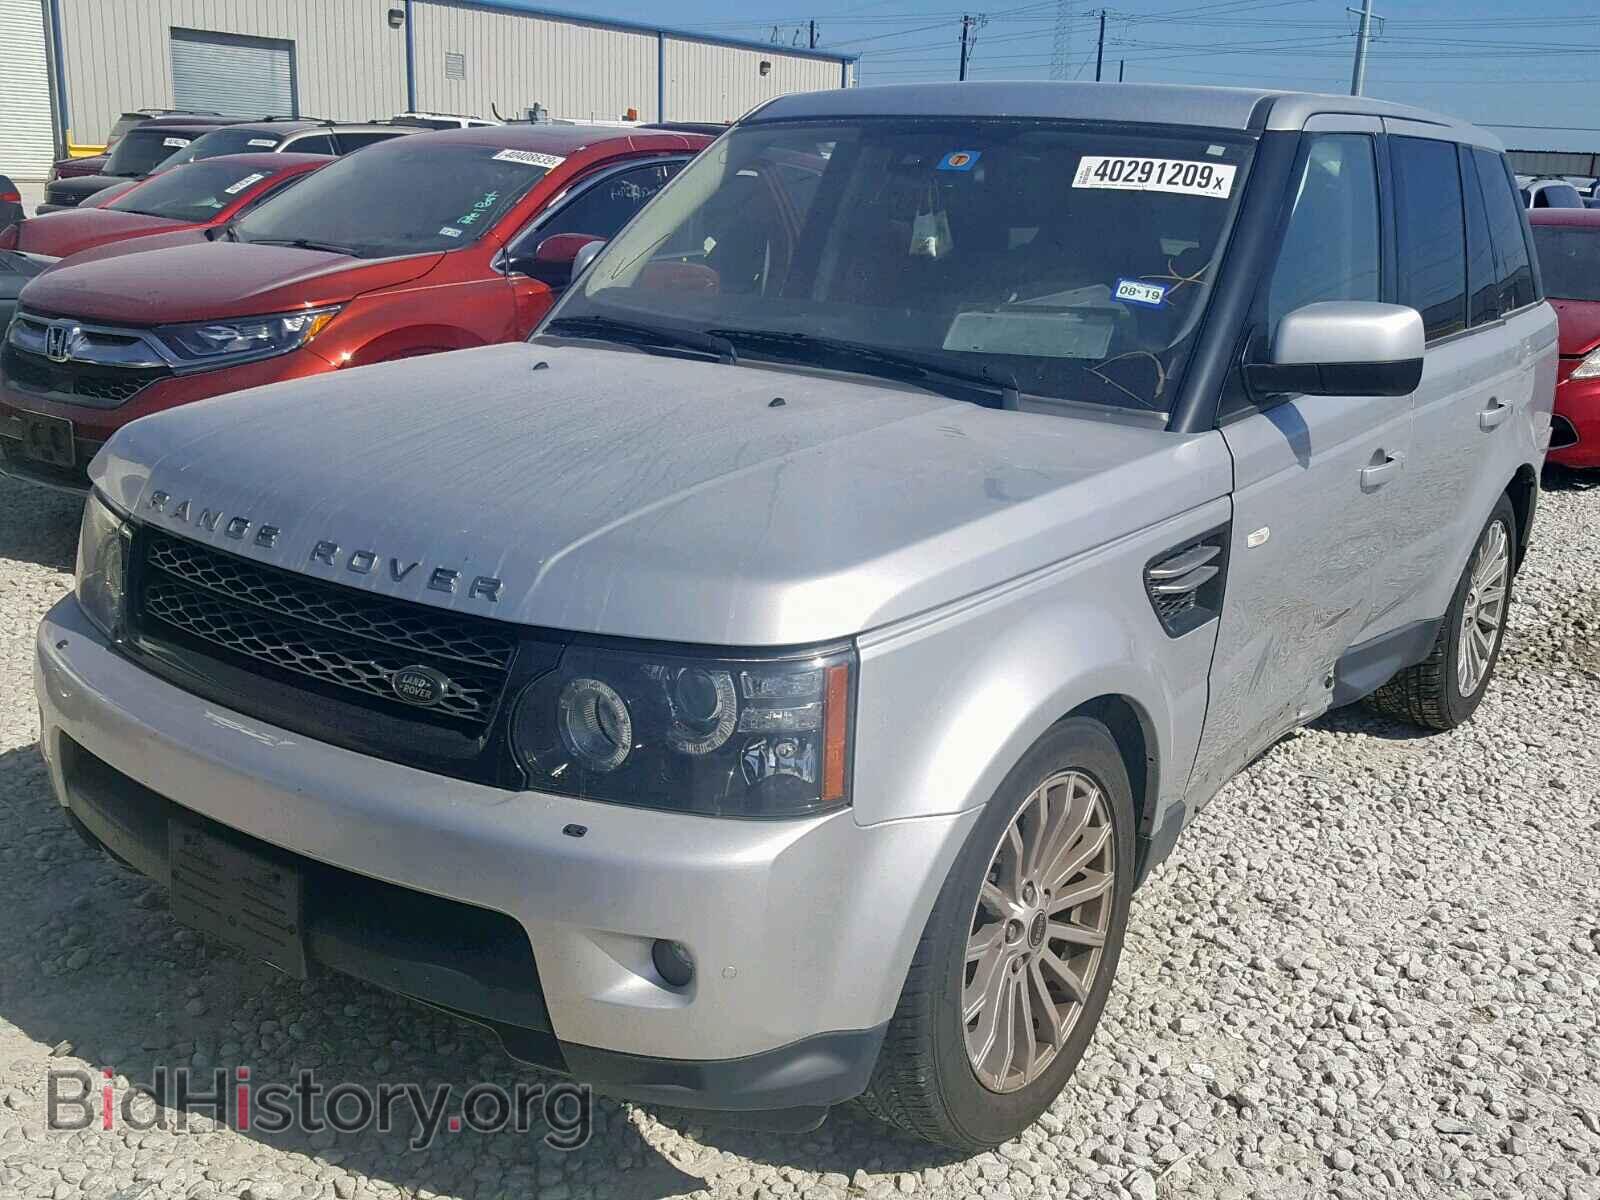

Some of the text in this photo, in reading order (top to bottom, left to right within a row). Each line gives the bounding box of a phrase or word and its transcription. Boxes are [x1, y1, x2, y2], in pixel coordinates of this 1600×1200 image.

[149, 490, 505, 603] RANGE ROVER
[402, 674, 426, 688] LAND
[402, 683, 432, 699] ROVER
